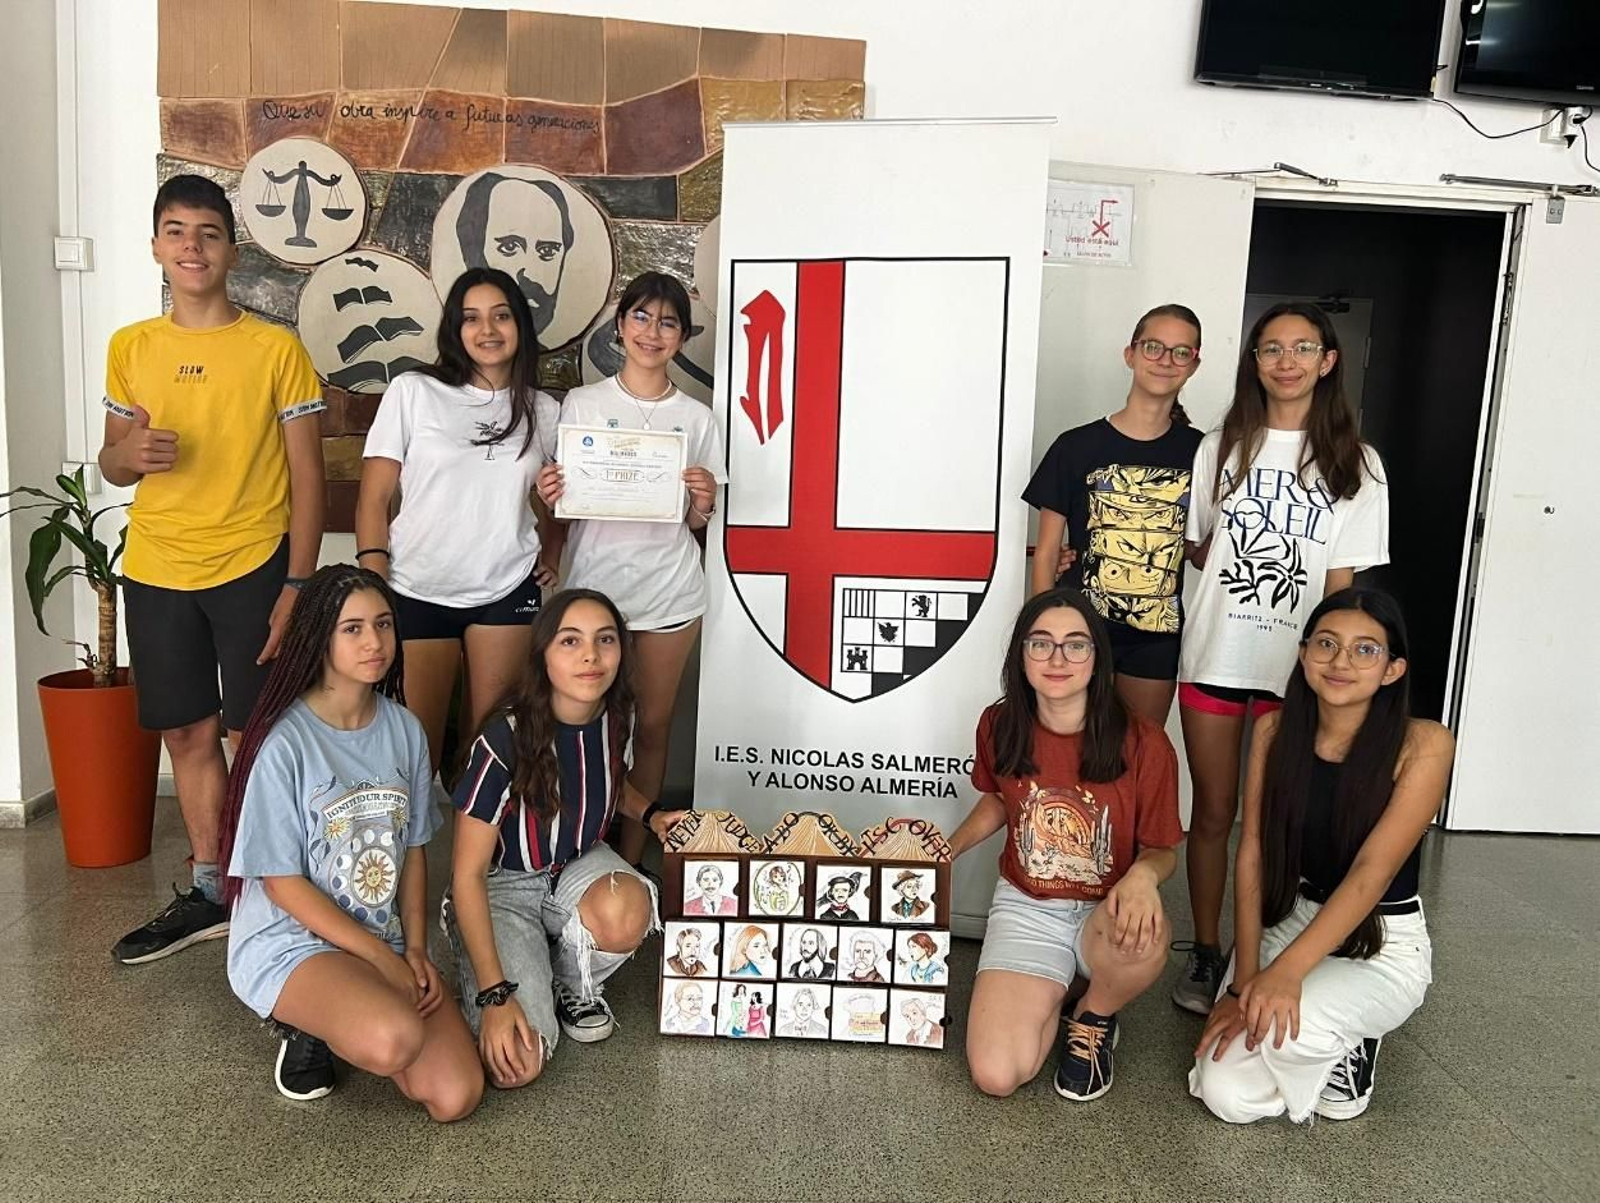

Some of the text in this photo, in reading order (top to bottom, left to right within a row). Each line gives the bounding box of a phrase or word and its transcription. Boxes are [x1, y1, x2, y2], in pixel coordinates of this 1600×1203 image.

[263, 101, 300, 120] Que
[340, 102, 376, 120] obra
[383, 103, 442, 124] inspire
[445, 109, 457, 121] a
[462, 103, 523, 131] futuras
[179, 365, 204, 374] SLOW
[1220, 497, 1326, 545] SOLEIL
[1228, 613, 1262, 622] BIARRITZ
[714, 745, 975, 776] I.E.S. NICOLAS SALMERÓ
[748, 770, 958, 799] Y ALONSO ALMERÍA
[666, 808, 706, 852] NEVER
[714, 812, 761, 853] JUDGE
[885, 816, 952, 862] COVER
[1038, 880, 1065, 890] THINGS
